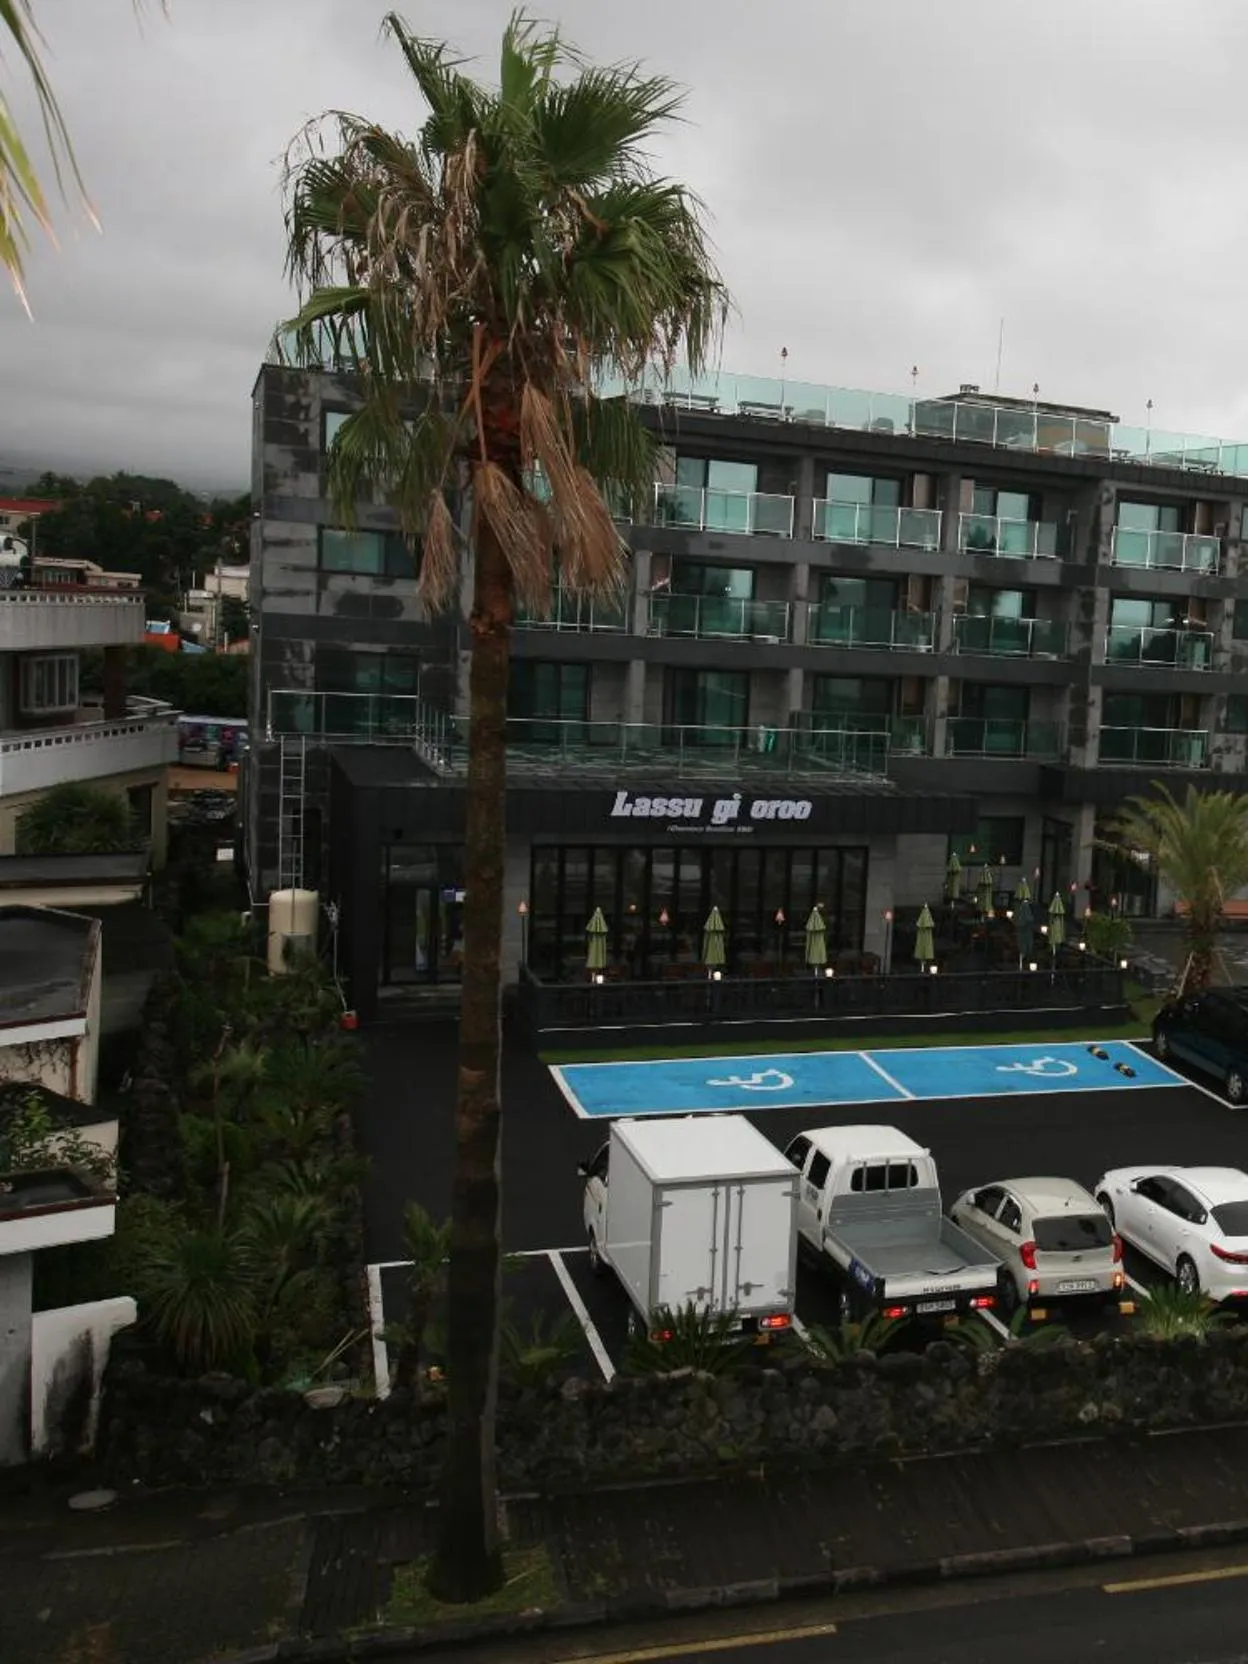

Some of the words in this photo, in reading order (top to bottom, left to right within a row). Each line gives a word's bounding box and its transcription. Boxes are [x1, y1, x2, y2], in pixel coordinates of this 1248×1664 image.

[610, 791, 703, 817] Lassu
[711, 793, 742, 823] gi
[750, 799, 813, 820] oroo
